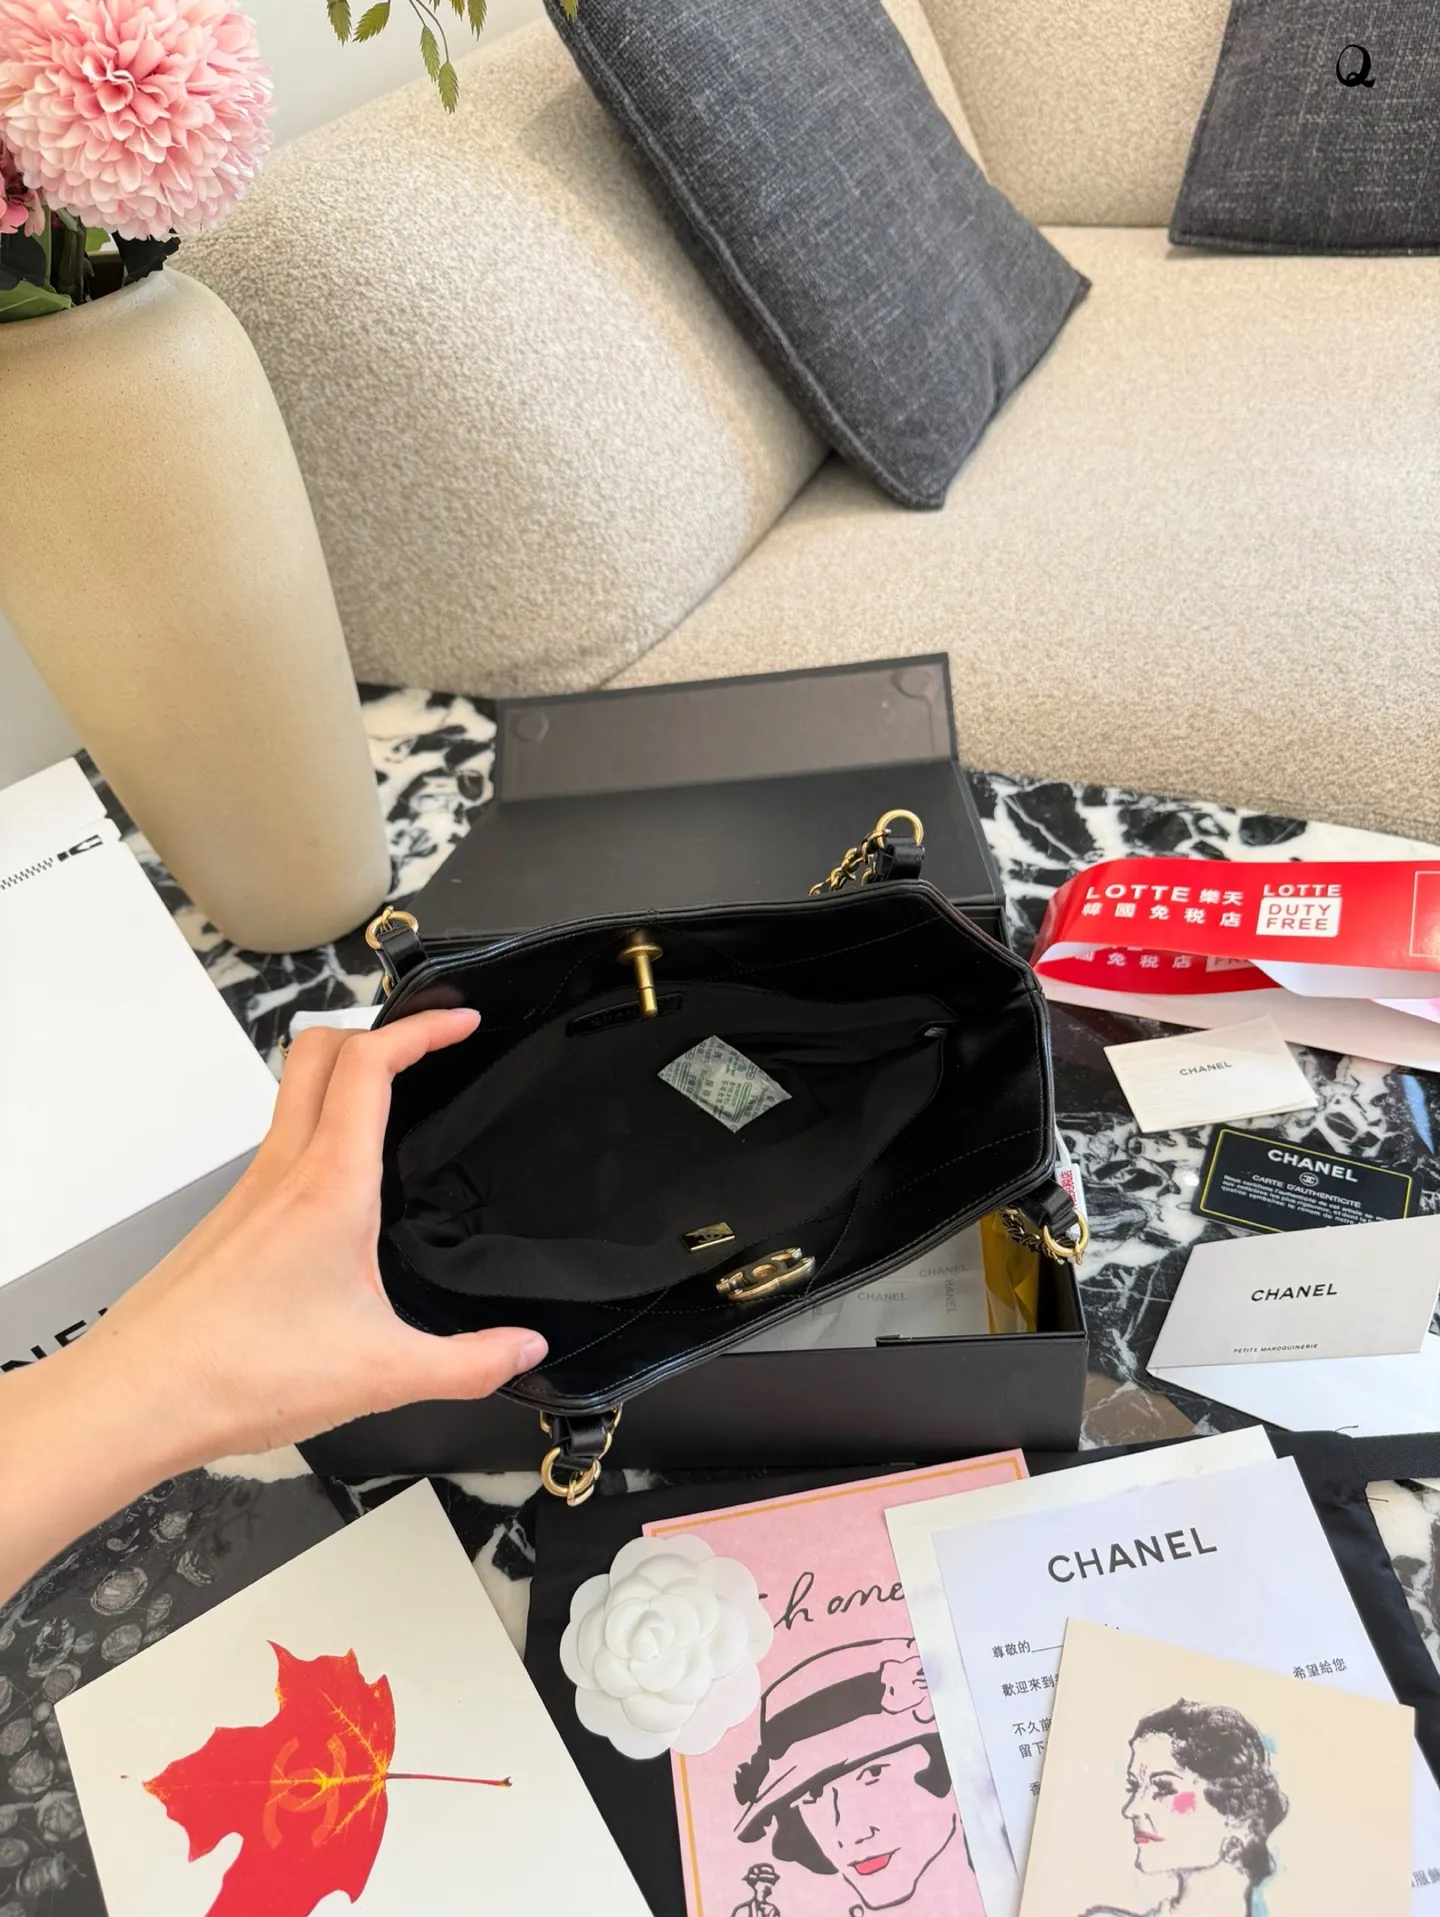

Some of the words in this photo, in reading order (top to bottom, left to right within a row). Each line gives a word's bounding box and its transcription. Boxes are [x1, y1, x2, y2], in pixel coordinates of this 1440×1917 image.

[1086, 884, 1191, 902] LOTTE
[1199, 888, 1243, 906] 樂天
[1263, 883, 1342, 897] LOTTE
[1267, 903, 1332, 916] DUTY
[1266, 917, 1328, 931] FREE
[1179, 1062, 1232, 1076] CHANEL
[1267, 1149, 1359, 1183] CHANEL
[1251, 1174, 1283, 1187] CARTE
[919, 1264, 969, 1277] CHANEL
[857, 1292, 907, 1301] CHANEL
[1251, 1283, 1338, 1301] CHANEL
[1260, 1343, 1319, 1352] MAROQUINERIE
[1047, 1527, 1218, 1583] CHANEL
[992, 1640, 1031, 1659] 尊敬的
[1293, 1657, 1347, 1679] 希望給您
[1002, 1673, 1059, 1697] 歡迎來到
[1018, 1740, 1048, 1759] 留下
